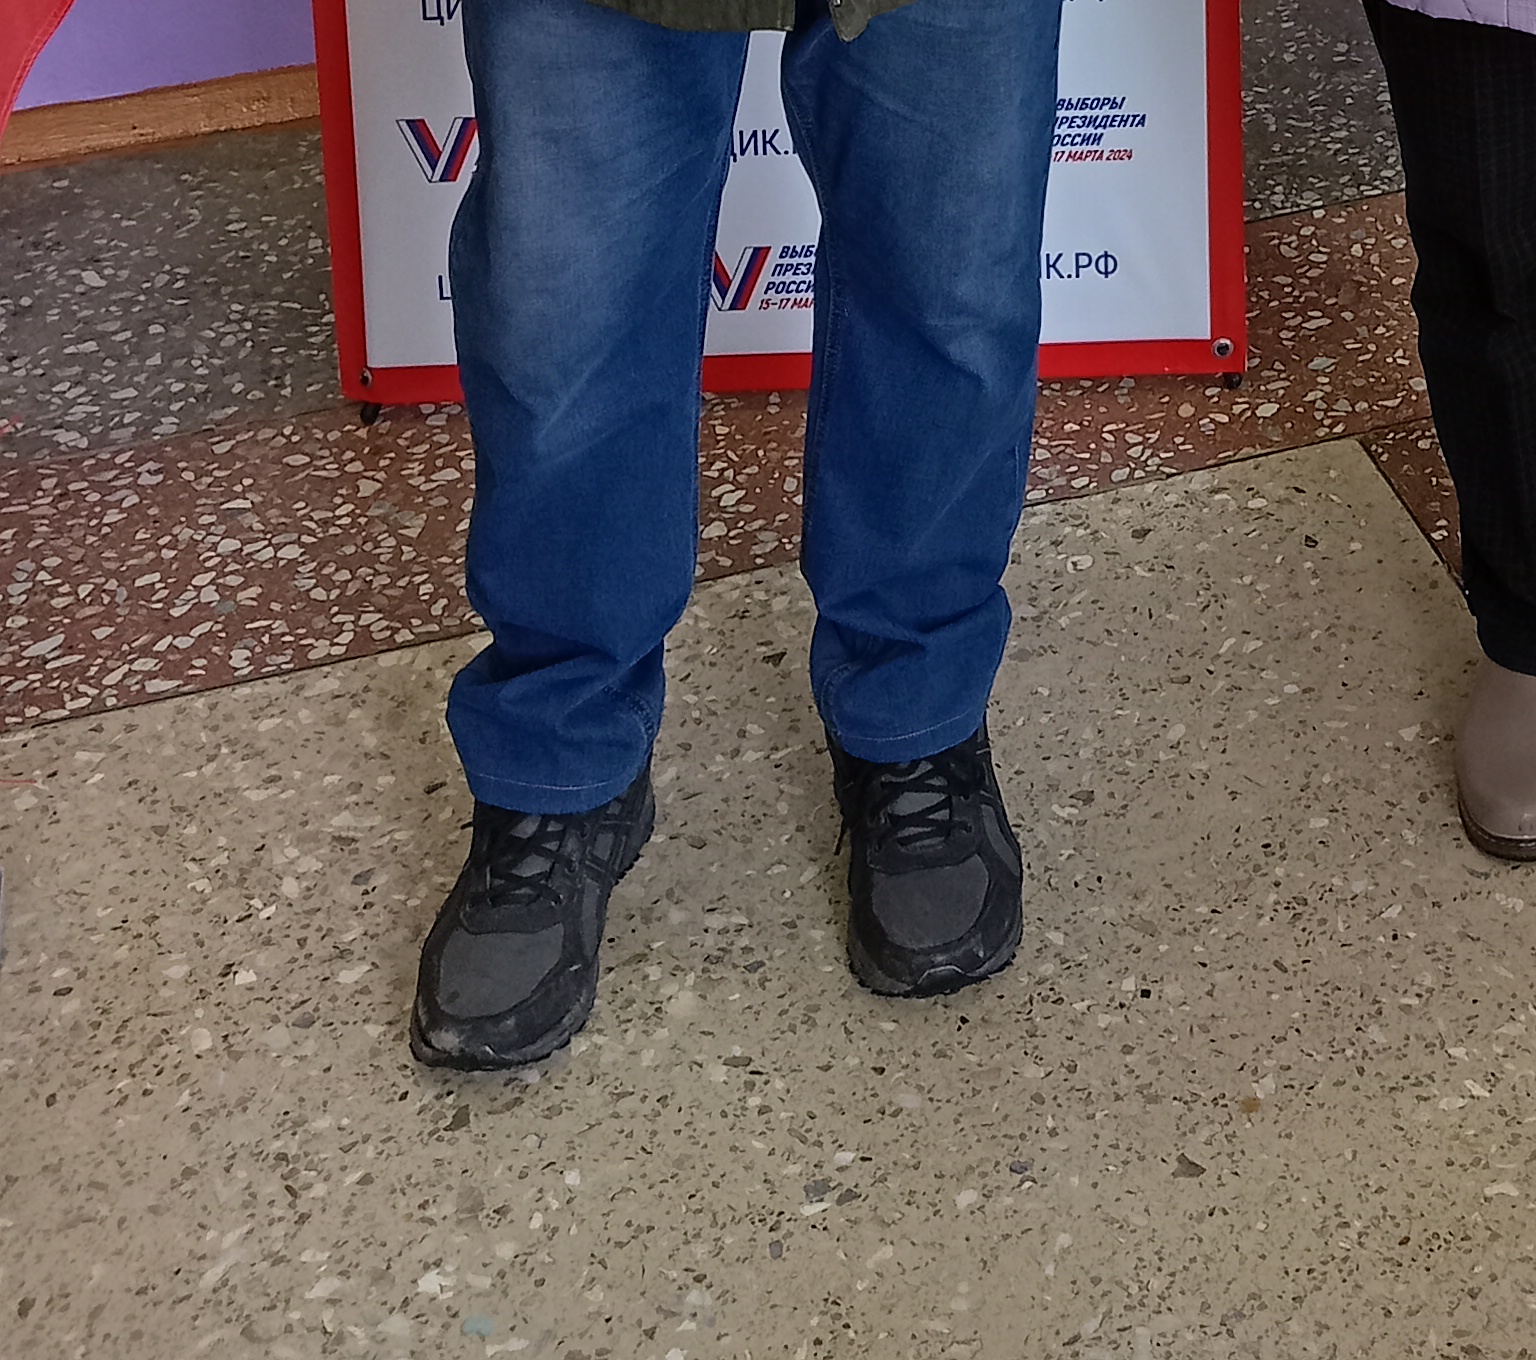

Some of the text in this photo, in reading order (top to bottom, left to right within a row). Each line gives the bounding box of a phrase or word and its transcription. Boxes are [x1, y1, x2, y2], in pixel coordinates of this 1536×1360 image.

[1056, 96, 1126, 111] ВЫБОРЫ
[1065, 149, 1105, 162] МАРТА
[1105, 149, 1133, 161] 2024
[778, 245, 817, 260] ВЫБ
[770, 262, 814, 277] ПРЕЗ
[1040, 250, 1118, 280] К.РФ
